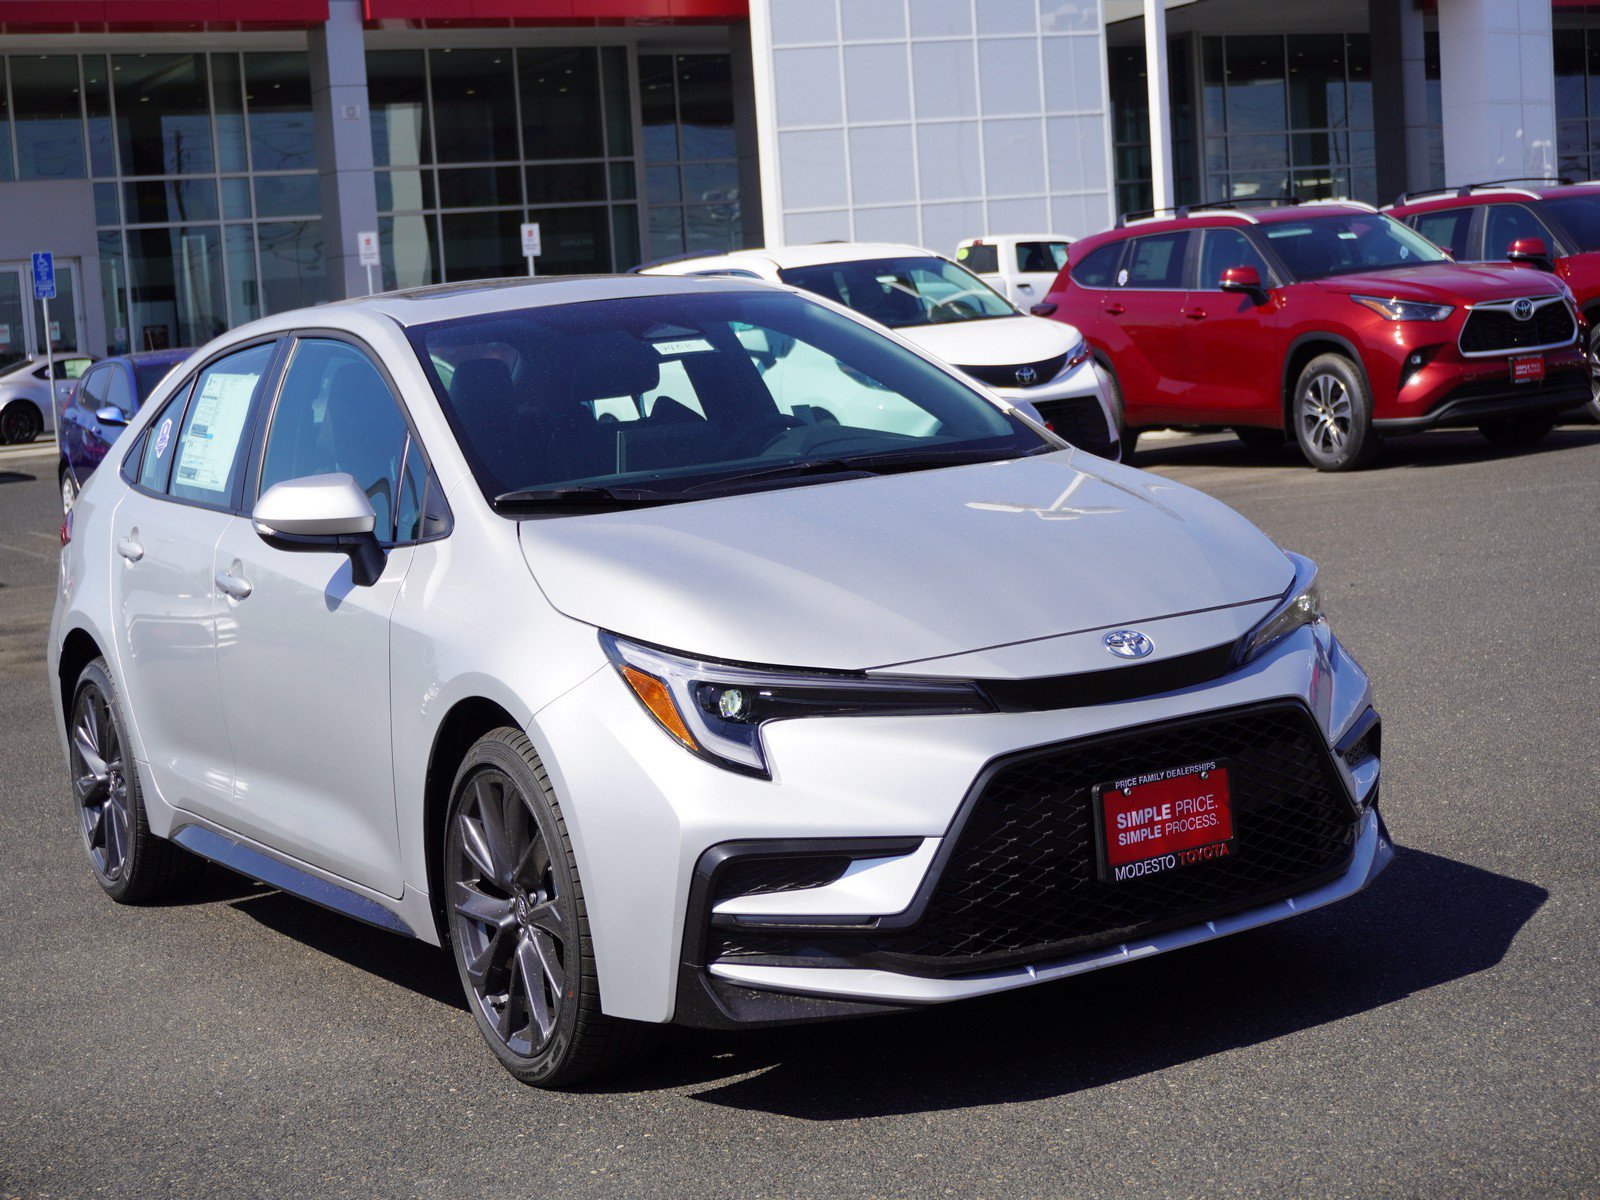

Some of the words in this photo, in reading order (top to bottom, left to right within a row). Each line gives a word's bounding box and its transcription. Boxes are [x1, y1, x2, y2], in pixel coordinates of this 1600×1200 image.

[1115, 777, 1137, 790] PRICE
[1138, 771, 1165, 784] FAMILY
[1166, 761, 1216, 778] DEALERSHIPS
[1116, 803, 1172, 829] SIMPLE
[1175, 794, 1218, 816] PRICE.
[1118, 825, 1162, 846] SIMPLE
[1165, 813, 1220, 835] PROCESS.
[1114, 854, 1176, 882] MODESTO
[1178, 842, 1230, 866] TOYOTA
